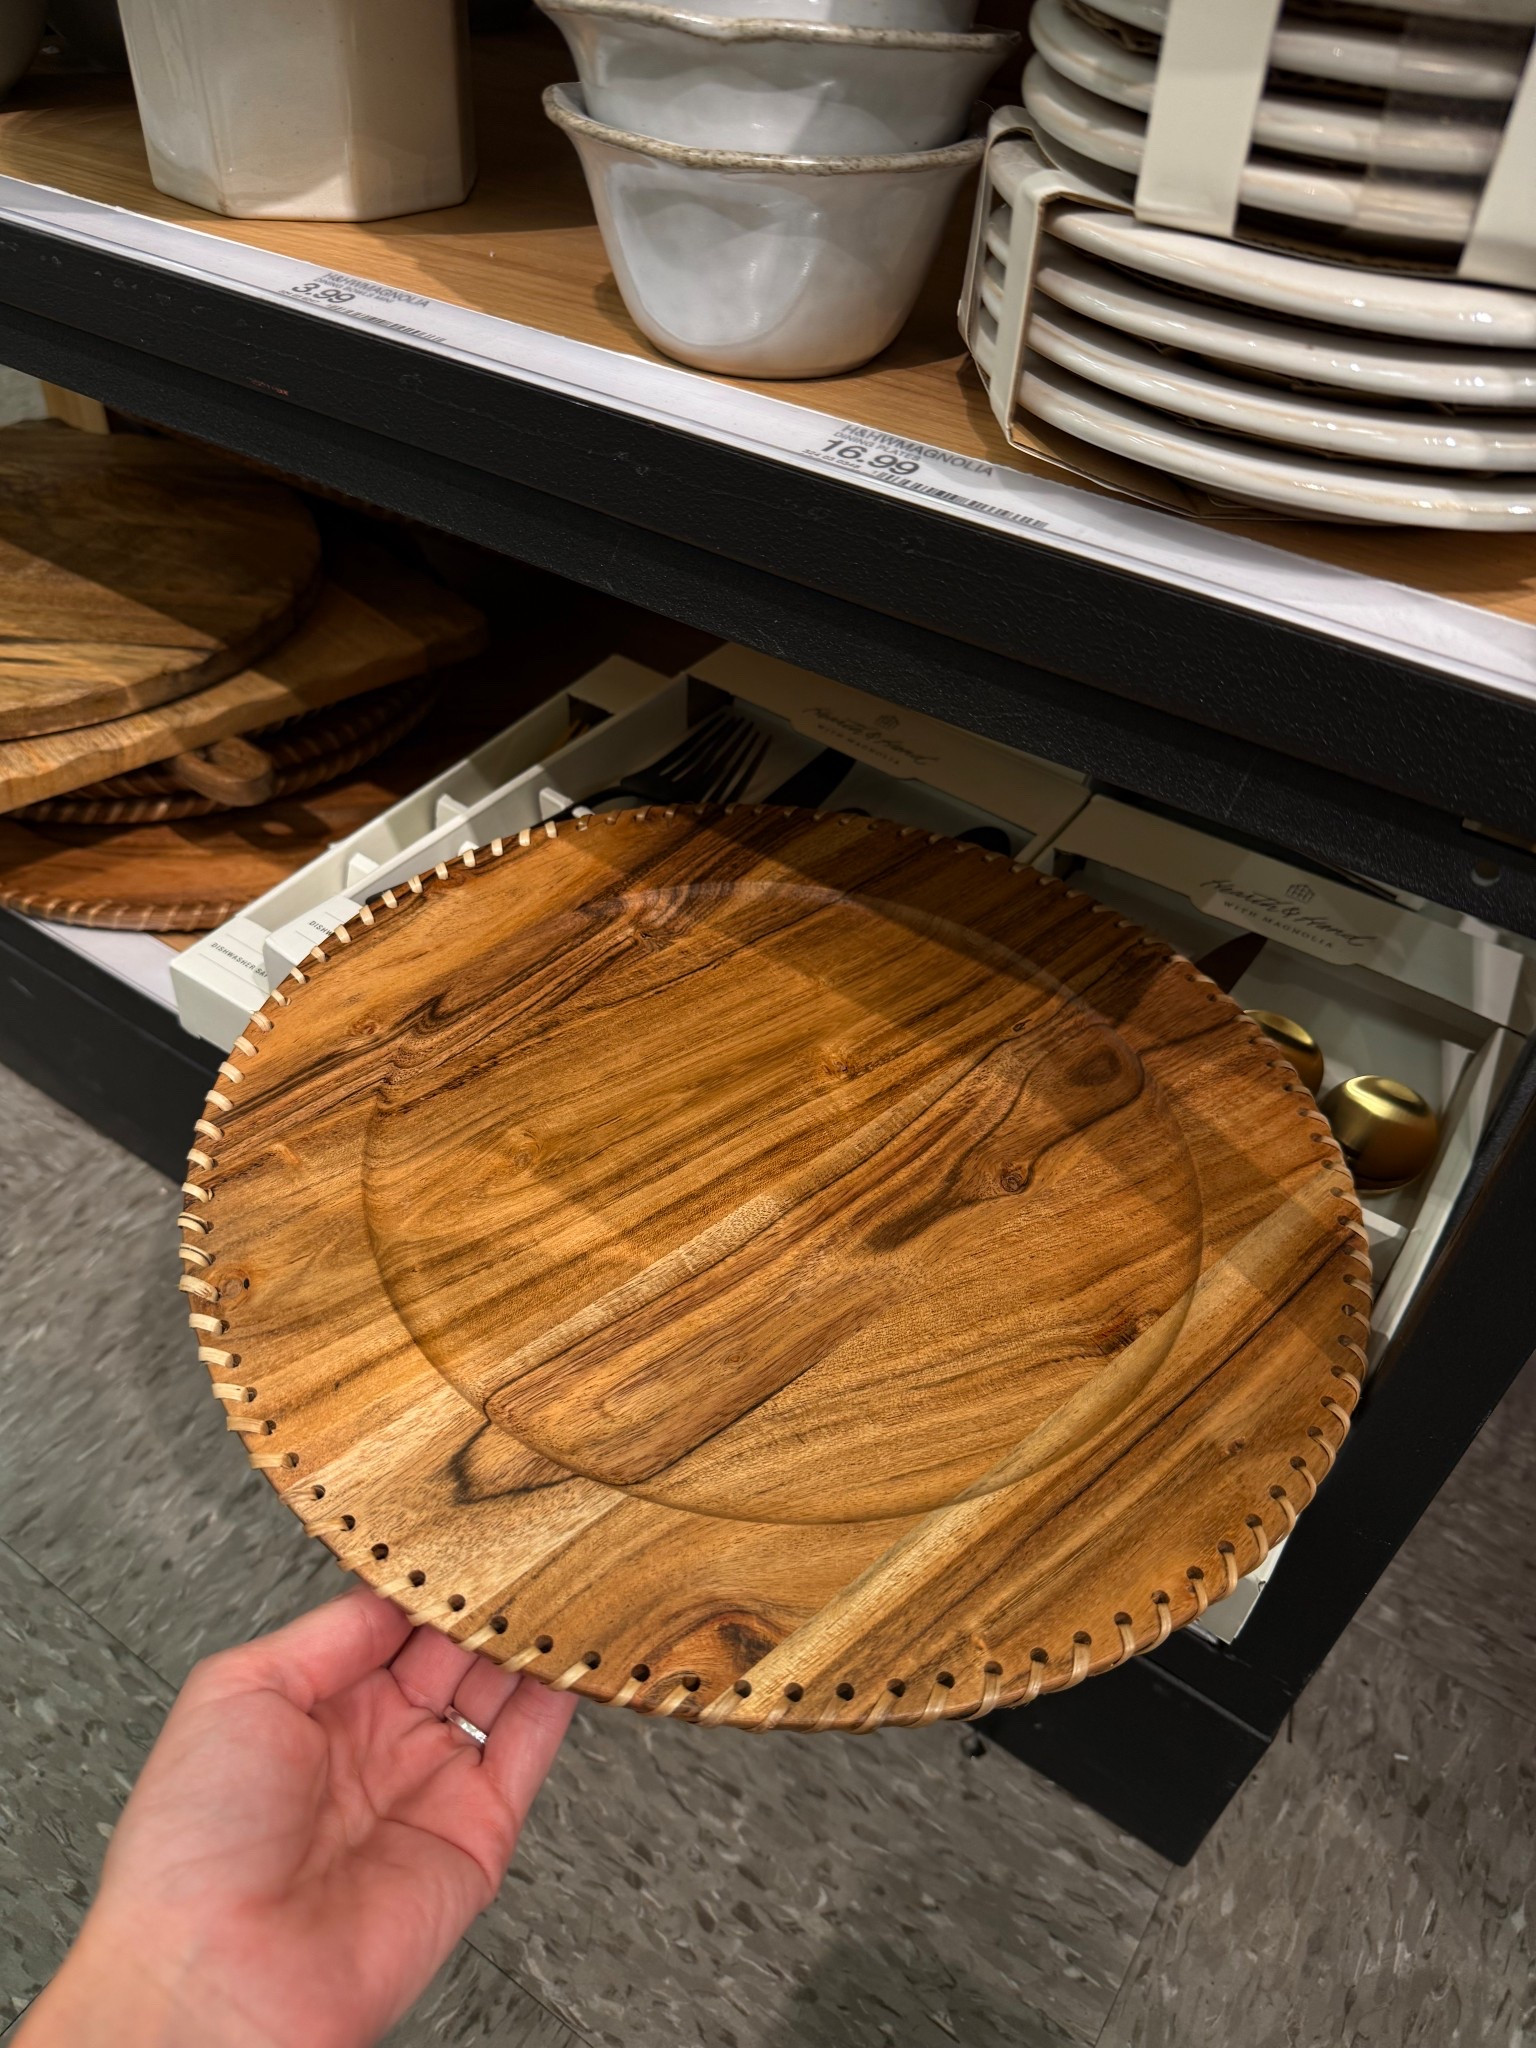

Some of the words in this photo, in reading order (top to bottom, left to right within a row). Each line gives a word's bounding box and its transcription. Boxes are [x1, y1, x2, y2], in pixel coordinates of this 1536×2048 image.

[291, 282, 356, 303] 3.99
[820, 438, 921, 475] 16.99
[833, 431, 875, 448] DINING
[875, 443, 921, 462] PLATES
[841, 424, 994, 477] H&HWMAGNOLIA
[1199, 879, 1294, 913] Hearth
[1293, 915, 1378, 947] Hand
[1222, 900, 1257, 919] WITH
[1261, 915, 1333, 949] MAGNOLIA
[210, 941, 256, 970] DISHWASHER
